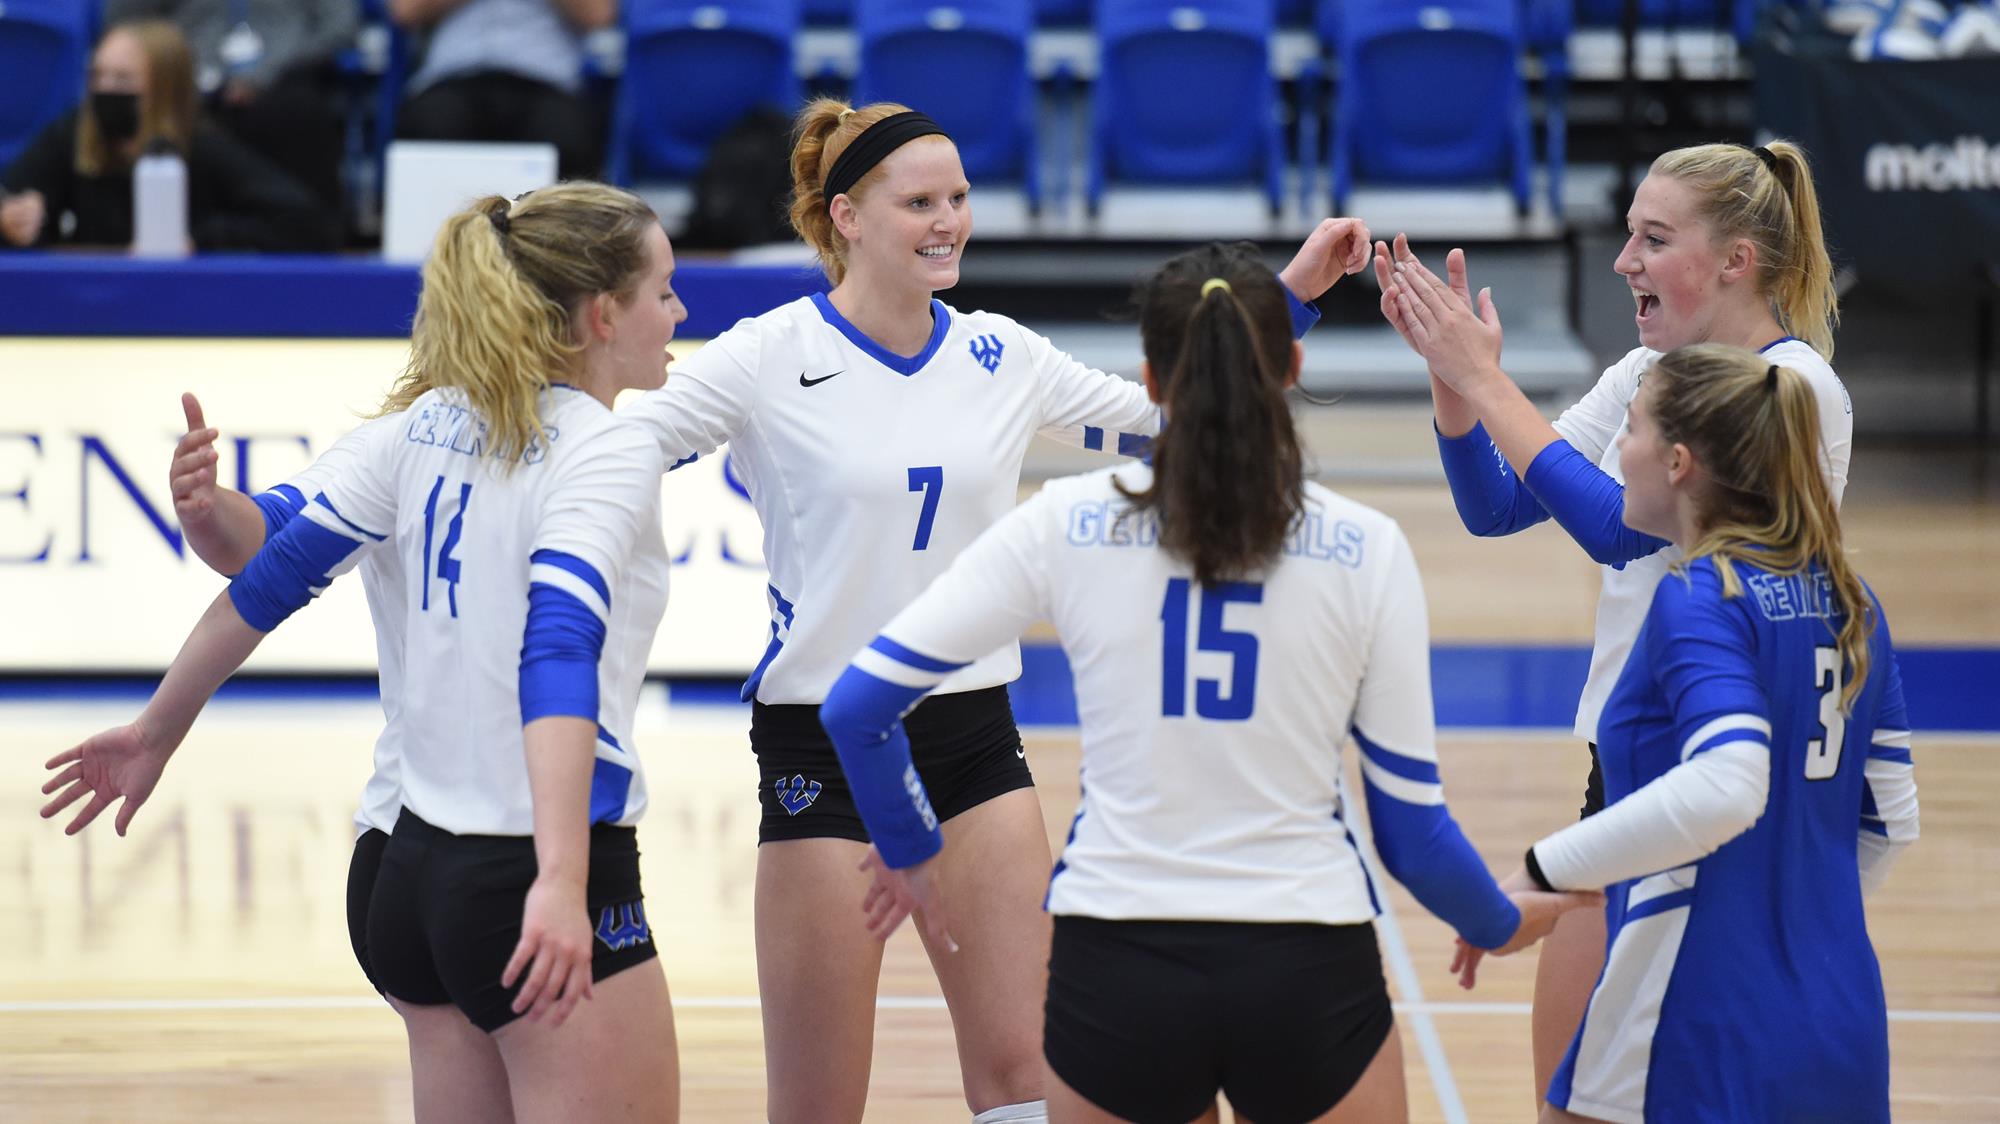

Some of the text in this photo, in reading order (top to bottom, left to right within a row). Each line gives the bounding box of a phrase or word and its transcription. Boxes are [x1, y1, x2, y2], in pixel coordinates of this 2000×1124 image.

[422, 474, 473, 619] 14
[907, 465, 944, 551] 7
[1160, 576, 1265, 721] 15
[1804, 645, 1847, 782] 3
